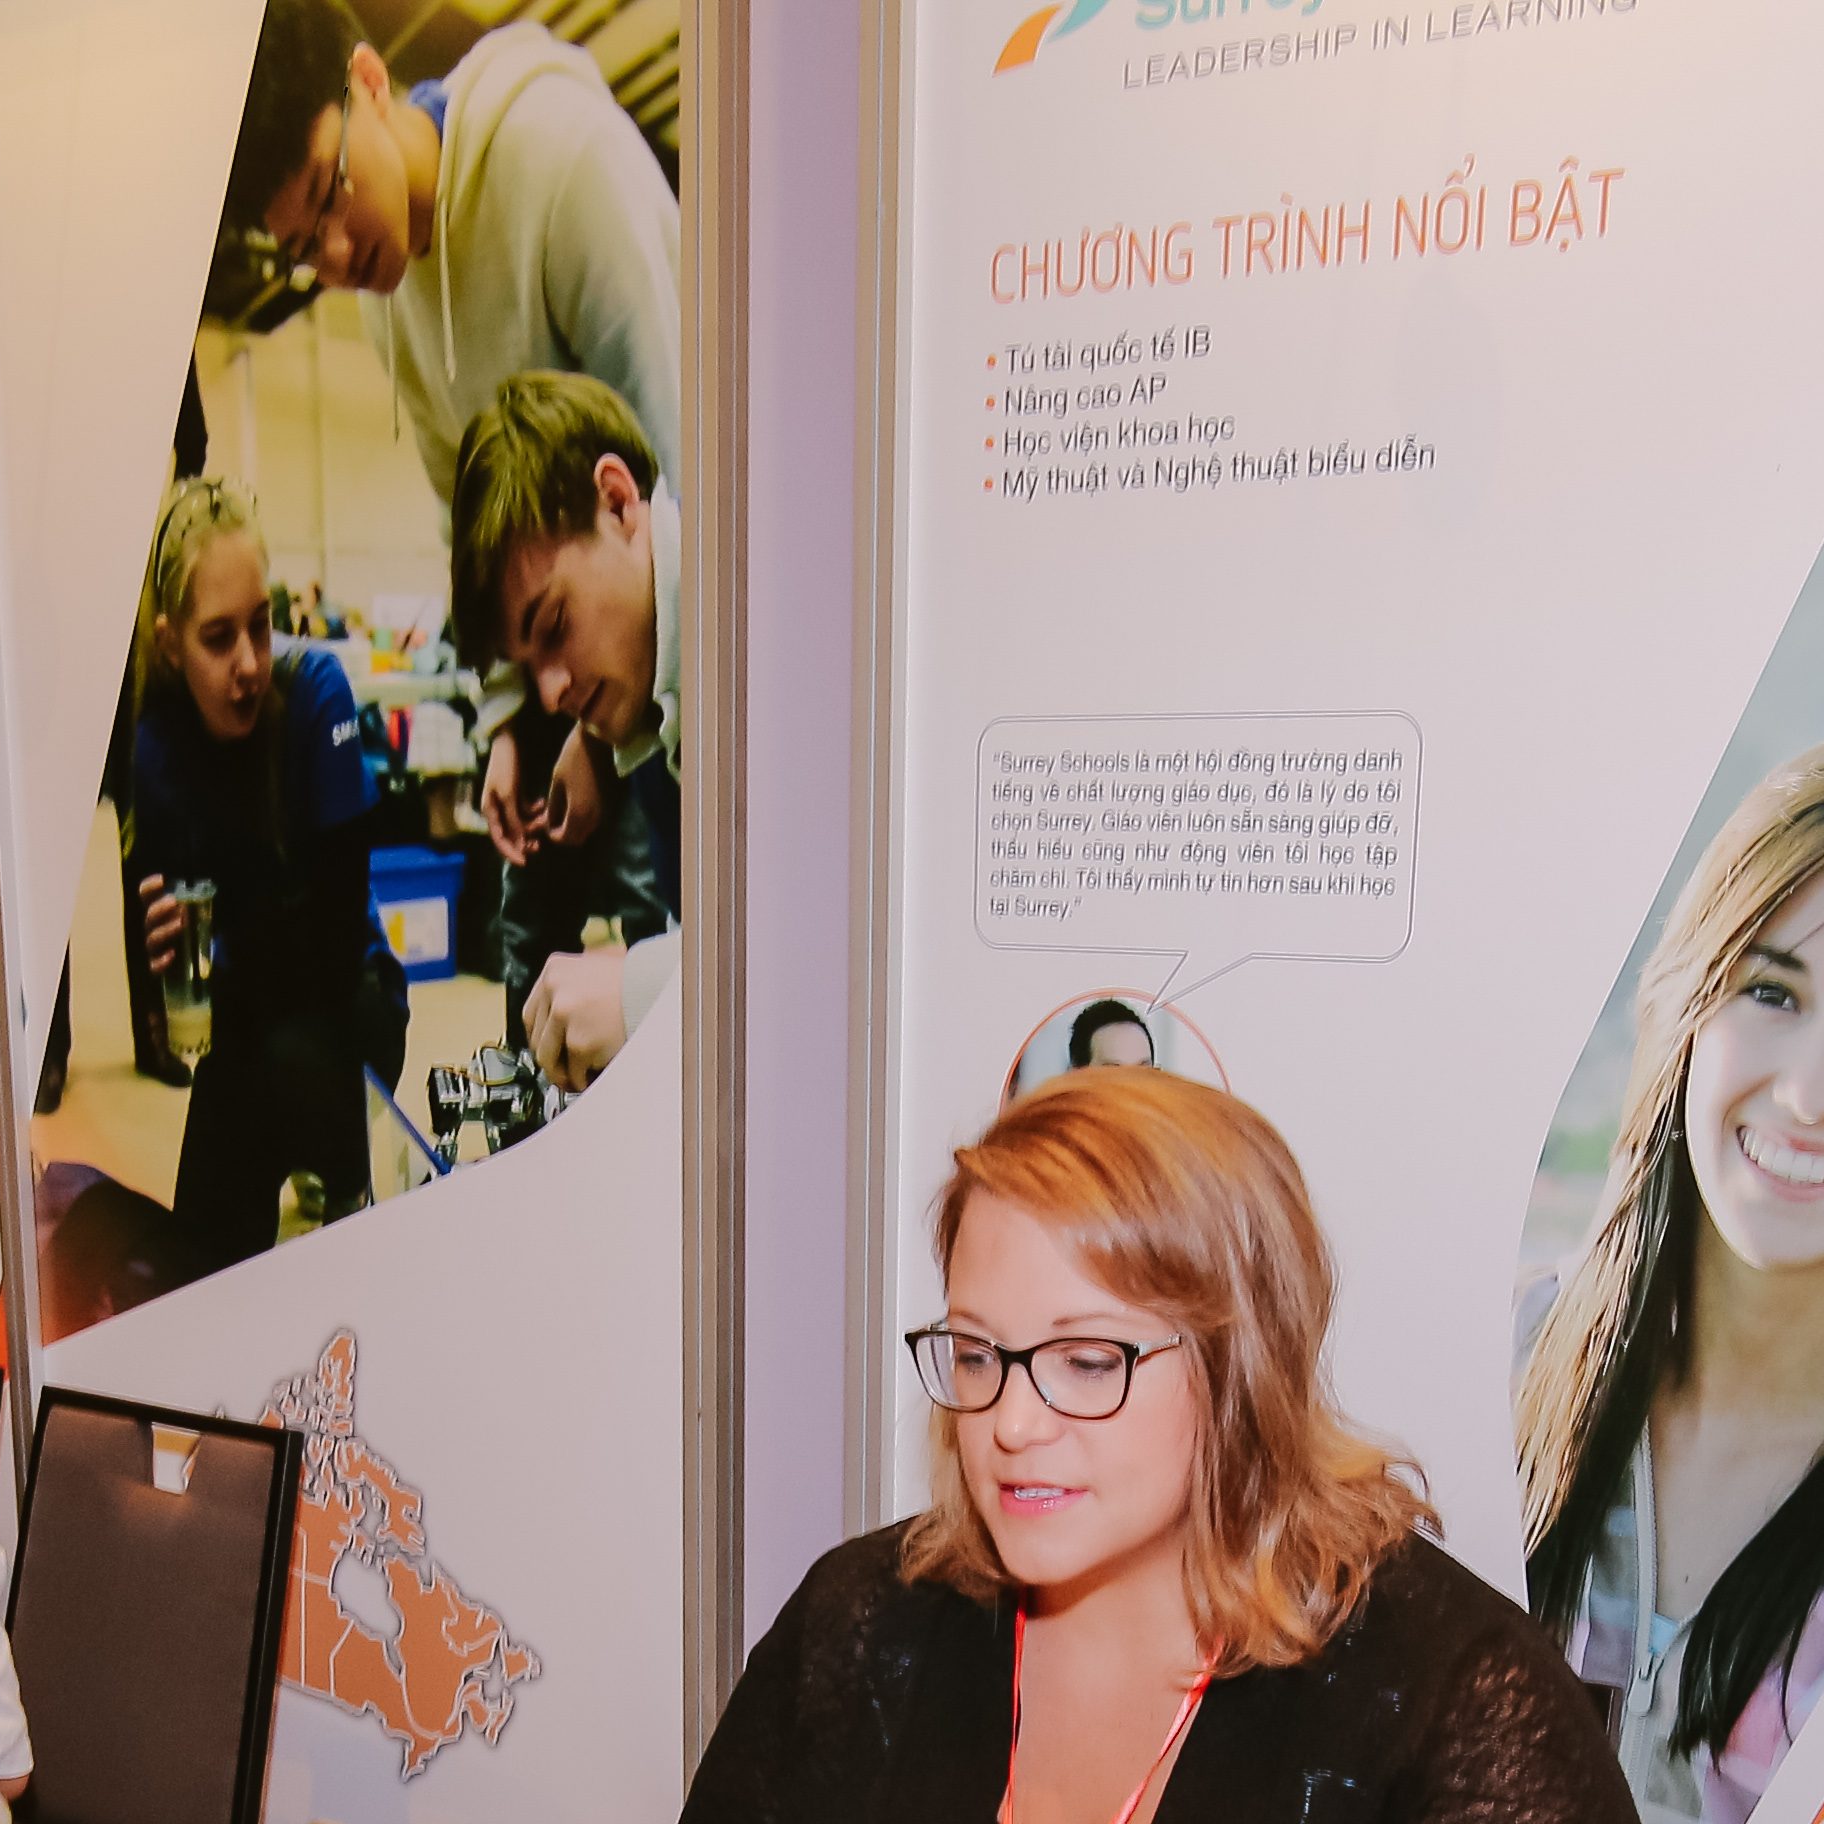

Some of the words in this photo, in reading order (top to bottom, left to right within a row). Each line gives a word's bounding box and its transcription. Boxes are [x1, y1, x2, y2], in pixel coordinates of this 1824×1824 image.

[1122, 23, 1357, 90] LEADERSHIP
[1371, 15, 1409, 49] IN
[990, 221, 1193, 304] CHƯƠNG
[1212, 192, 1372, 279] TRÌNH
[1393, 153, 1487, 260] NỔI
[1510, 155, 1625, 252] BẬT
[1005, 343, 1036, 375] Tú
[1043, 338, 1072, 371] tài
[1080, 328, 1143, 374] quốc
[1151, 325, 1176, 362] tế
[1183, 325, 1212, 358] IB
[1004, 384, 1069, 419] Nâng
[1077, 383, 1122, 410] cao
[1129, 372, 1167, 405] AP
[1003, 427, 1052, 461] Học
[1060, 420, 1110, 456] viện
[1117, 416, 1178, 449] khoa
[1187, 411, 1237, 448] học
[1002, 464, 1039, 504] Mỹ
[1047, 461, 1109, 497] thuật
[1118, 458, 1145, 488] và
[1153, 451, 1223, 493] Nghệ
[1231, 446, 1299, 485] thuật
[1307, 438, 1367, 477] biểu
[1376, 433, 1436, 472] diễn
[1061, 750, 1129, 773] Schools
[1135, 750, 1149, 772] là
[1155, 750, 1189, 775] một
[1195, 749, 1222, 775] hội
[1228, 746, 1275, 776] đồng
[1281, 748, 1347, 776] trường
[1354, 748, 1403, 773] danh
[992, 777, 1033, 806] tiếng
[1041, 777, 1060, 802] về
[1066, 777, 1104, 802] chất
[1111, 780, 1164, 806] lượng
[1172, 779, 1210, 806] giáo
[1218, 780, 1257, 806] dục,
[1265, 779, 1290, 802] đó
[1297, 779, 1312, 802] là
[1321, 780, 1337, 807] lý
[1344, 779, 1369, 802] do
[1377, 779, 1401, 802] tôi
[991, 810, 1032, 836] chọn
[1037, 808, 1096, 835] Surrey.
[1101, 808, 1142, 831] Giáo
[1148, 809, 1182, 832] viên
[1187, 811, 1224, 832] luôn
[1230, 807, 1263, 833] sẵn
[1268, 811, 1314, 838] sàng
[1319, 810, 1360, 839] giúp
[1365, 811, 1399, 837] đỡ,
[991, 836, 1027, 860] thấu
[1037, 836, 1072, 860] hiểu
[1082, 839, 1124, 864] cũng
[1135, 839, 1171, 862] như
[1181, 840, 1226, 867] động
[1237, 839, 1274, 863] viên
[1285, 840, 1309, 864] tôi
[1318, 841, 1355, 868] học
[1365, 842, 1398, 869] tập
[990, 866, 1036, 888] chăm
[1076, 867, 1101, 889] Tôi
[1106, 866, 1143, 895] thấy
[1148, 868, 1190, 891] mình
[1196, 871, 1215, 894] tự
[1220, 870, 1241, 892] tin
[1247, 870, 1284, 893] hơn
[1289, 876, 1322, 895] sau
[1327, 871, 1355, 895] khi
[1360, 872, 1396, 900] học
[990, 895, 1009, 919] tại
